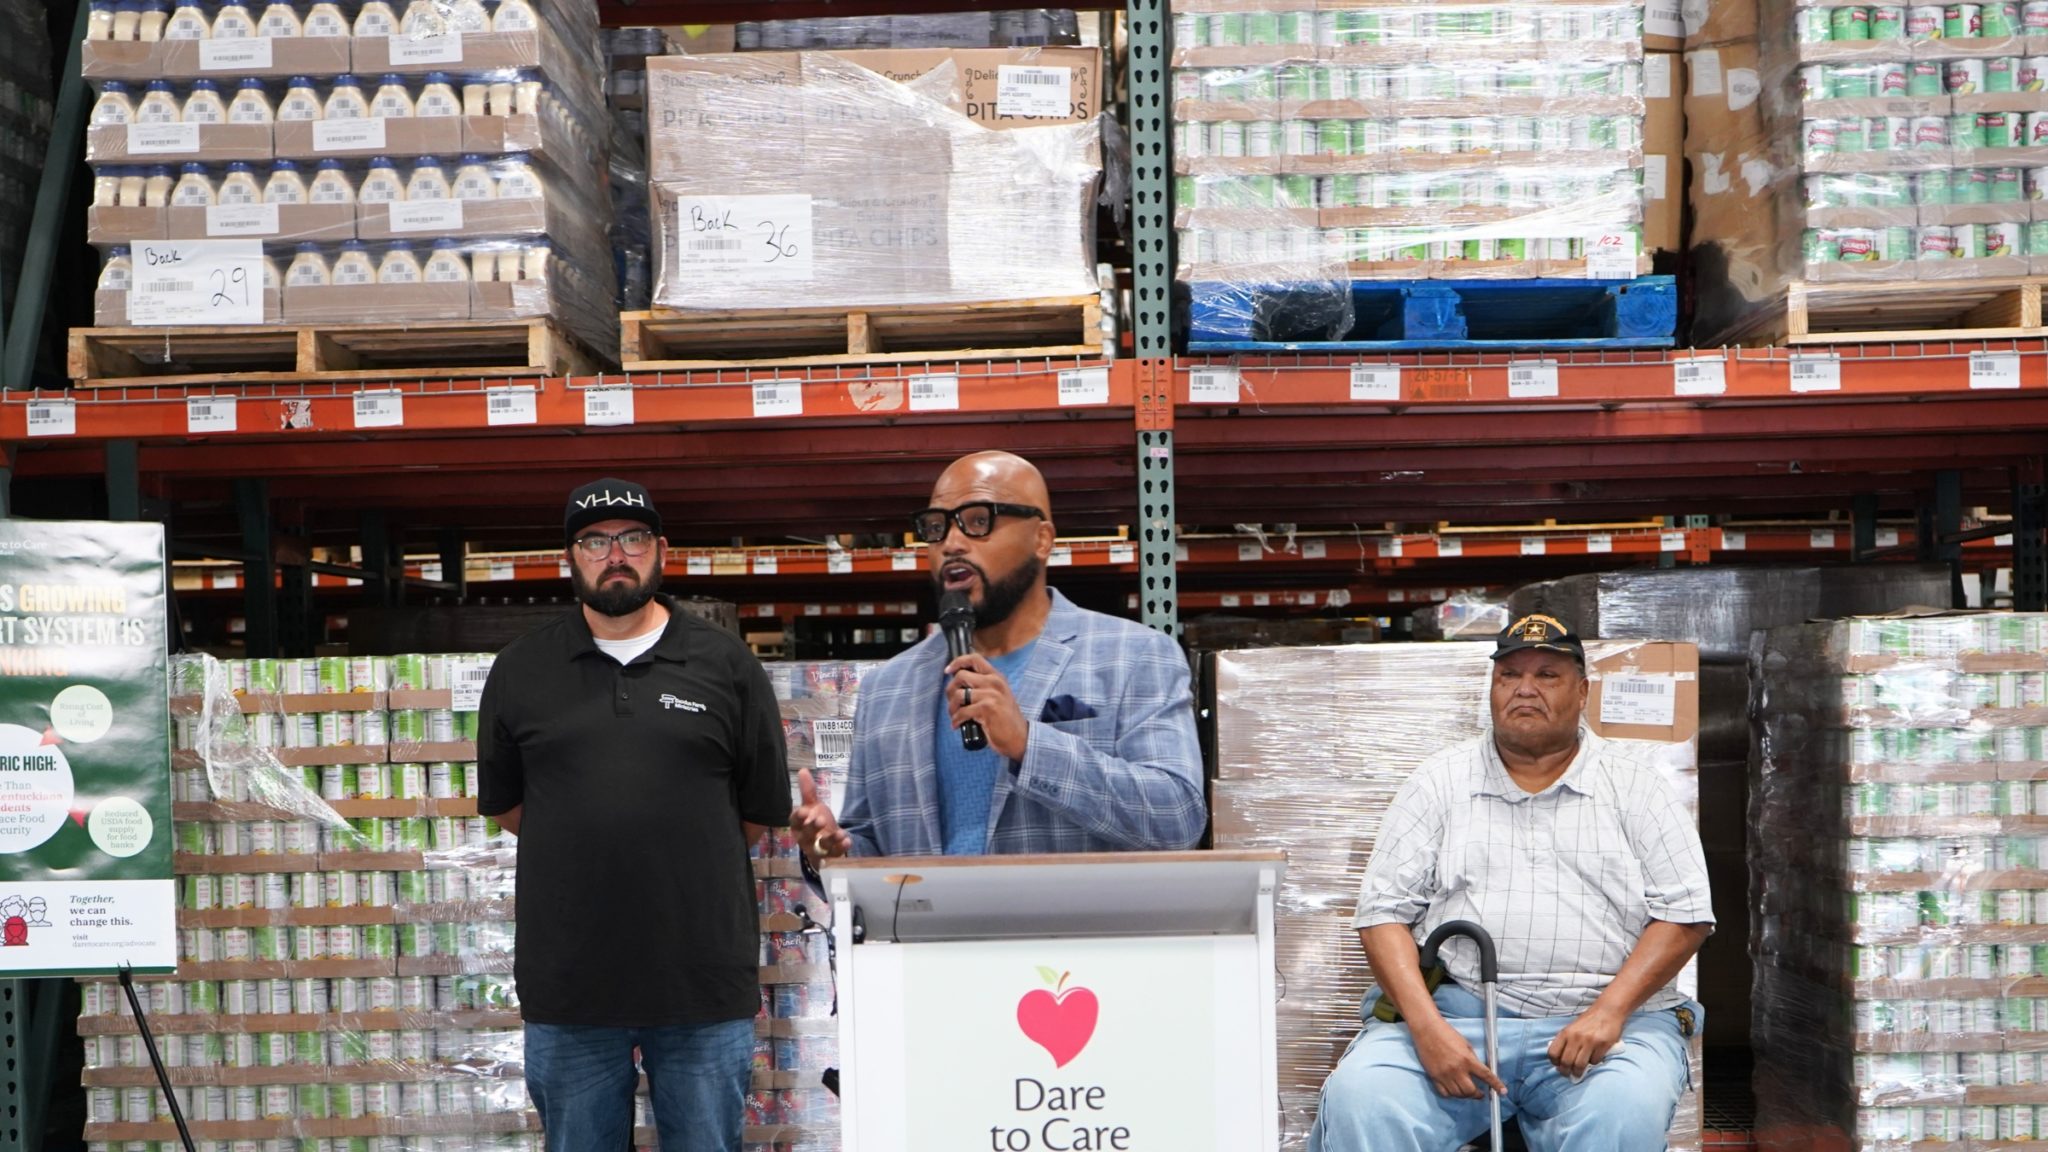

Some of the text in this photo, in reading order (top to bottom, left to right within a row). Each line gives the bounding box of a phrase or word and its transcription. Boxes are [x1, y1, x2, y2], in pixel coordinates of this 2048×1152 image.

[691, 205, 738, 233] Back
[757, 220, 798, 263] 36
[144, 247, 182, 266] Back
[209, 267, 249, 307] 29
[19, 584, 127, 613] GROWING
[0, 616, 146, 646] T SYSTEM IS
[23, 755, 57, 771] HIGH:
[4, 780, 32, 790] Than
[19, 814, 45, 824] Food
[106, 832, 119, 841] for
[69, 894, 116, 906] Together,
[69, 907, 106, 915] we can
[69, 916, 134, 929] change this.
[72, 933, 89, 941] visit
[1014, 1077, 1106, 1112] Dare
[990, 1117, 1131, 1152] to Care
